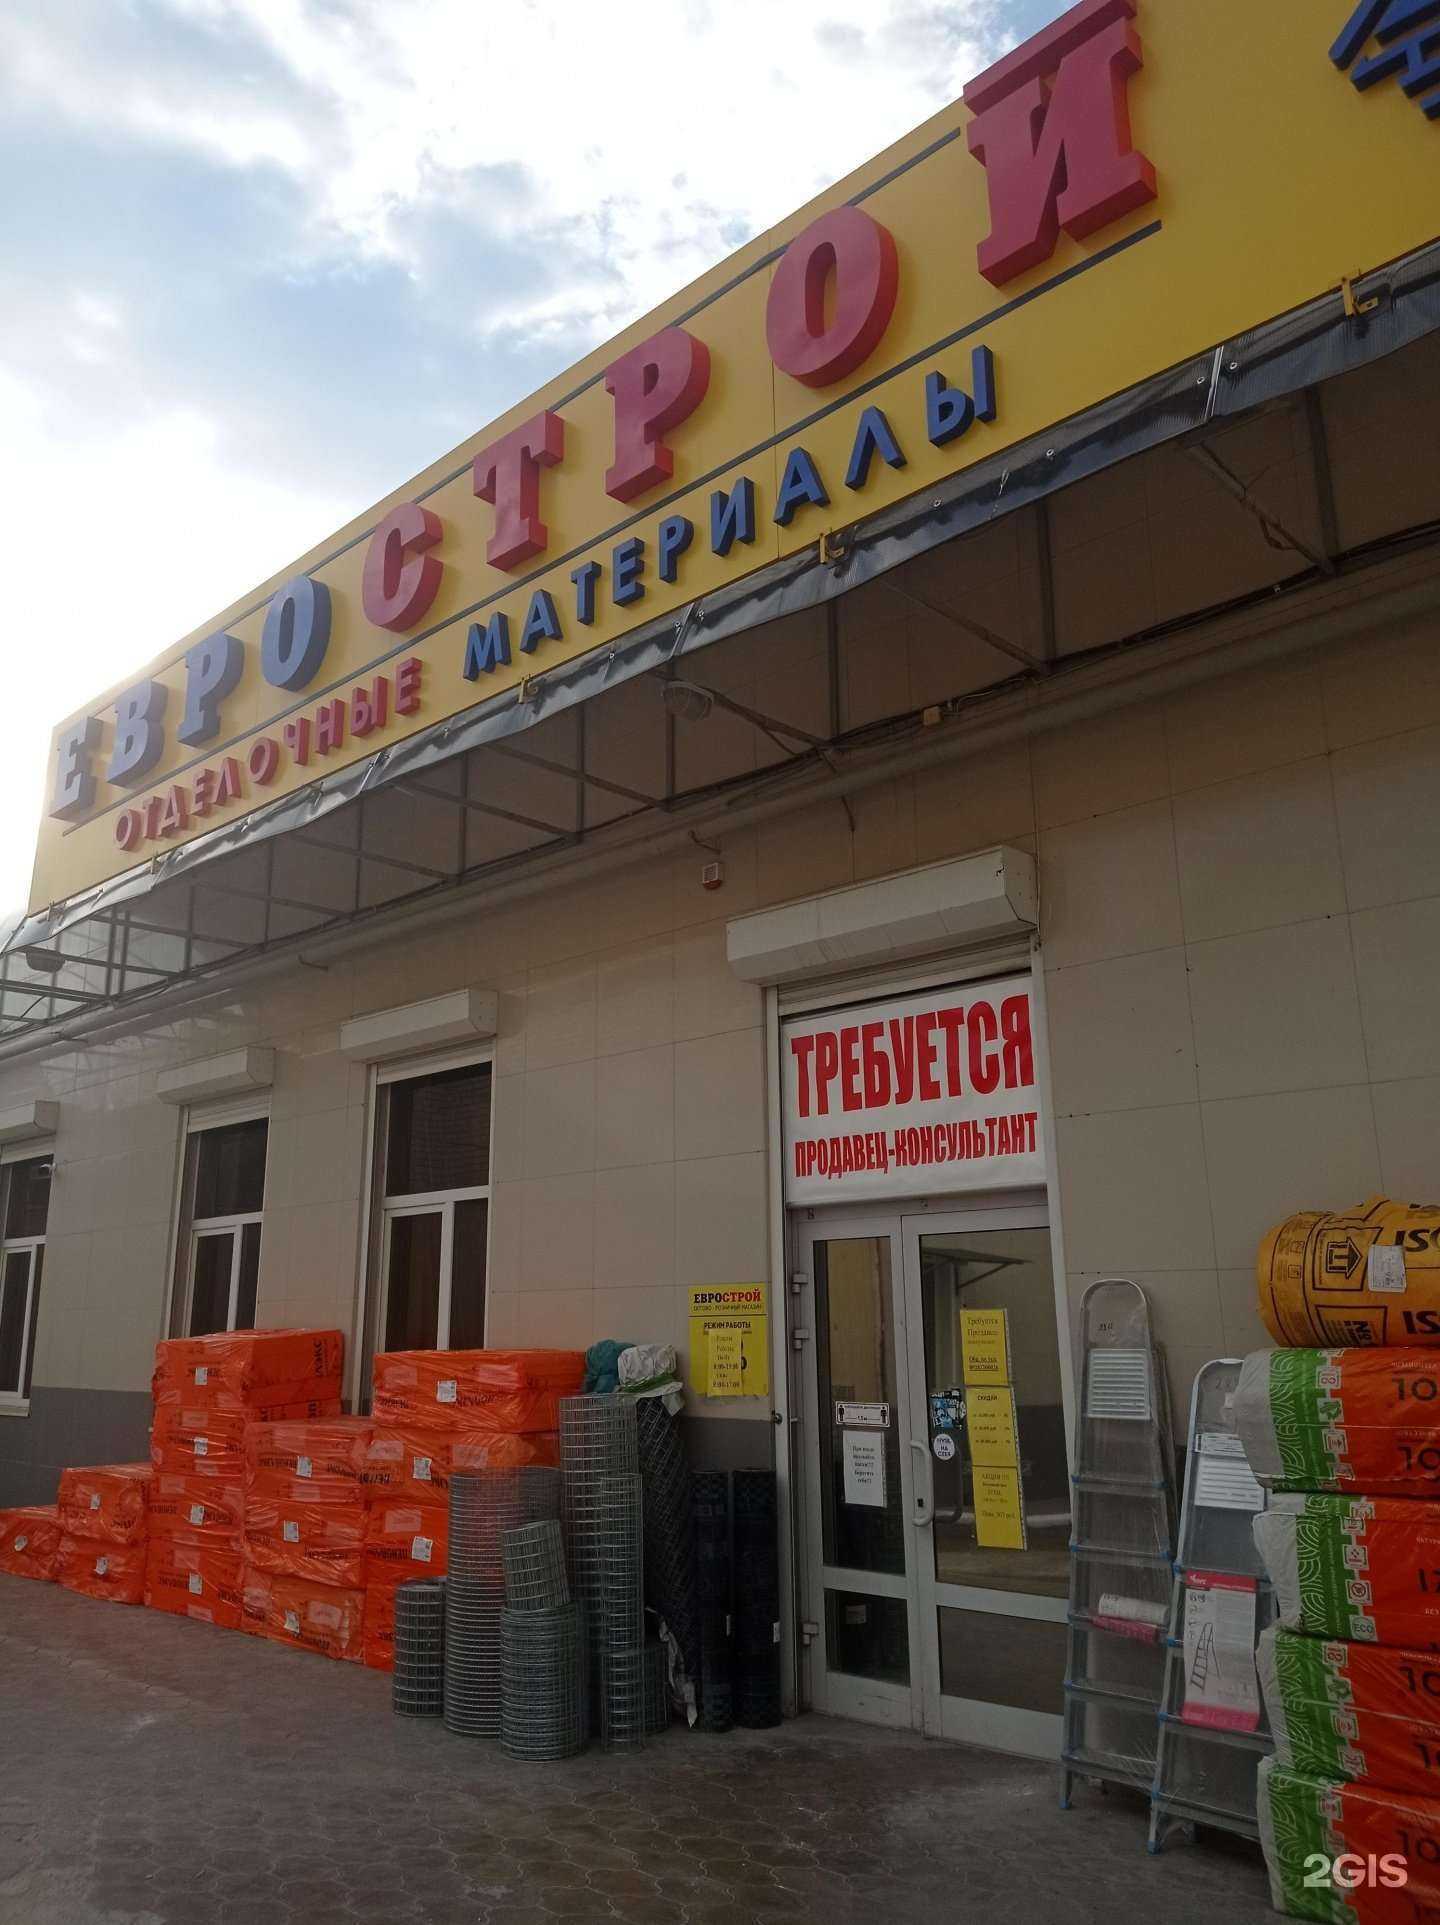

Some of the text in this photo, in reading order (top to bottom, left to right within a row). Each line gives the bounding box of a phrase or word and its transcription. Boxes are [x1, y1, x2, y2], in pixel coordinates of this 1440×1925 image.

[49, 0, 1158, 820] ЕВРОСТРОЙ
[113, 344, 996, 851] ОТДЕЛОЧНЫЕ МАТЕРИАЛЫ
[791, 994, 1034, 1117] ТРЕБУЕТСЯ
[795, 1112, 1038, 1179] ПРОДАВЕЦ-КОНСУЛЬТАНТ
[694, 1288, 761, 1304] ЕВРОСТРОЙ
[704, 1321, 751, 1329] РЕЖИМ РАБОТЫ
[1353, 1623, 1373, 1633] ECO
